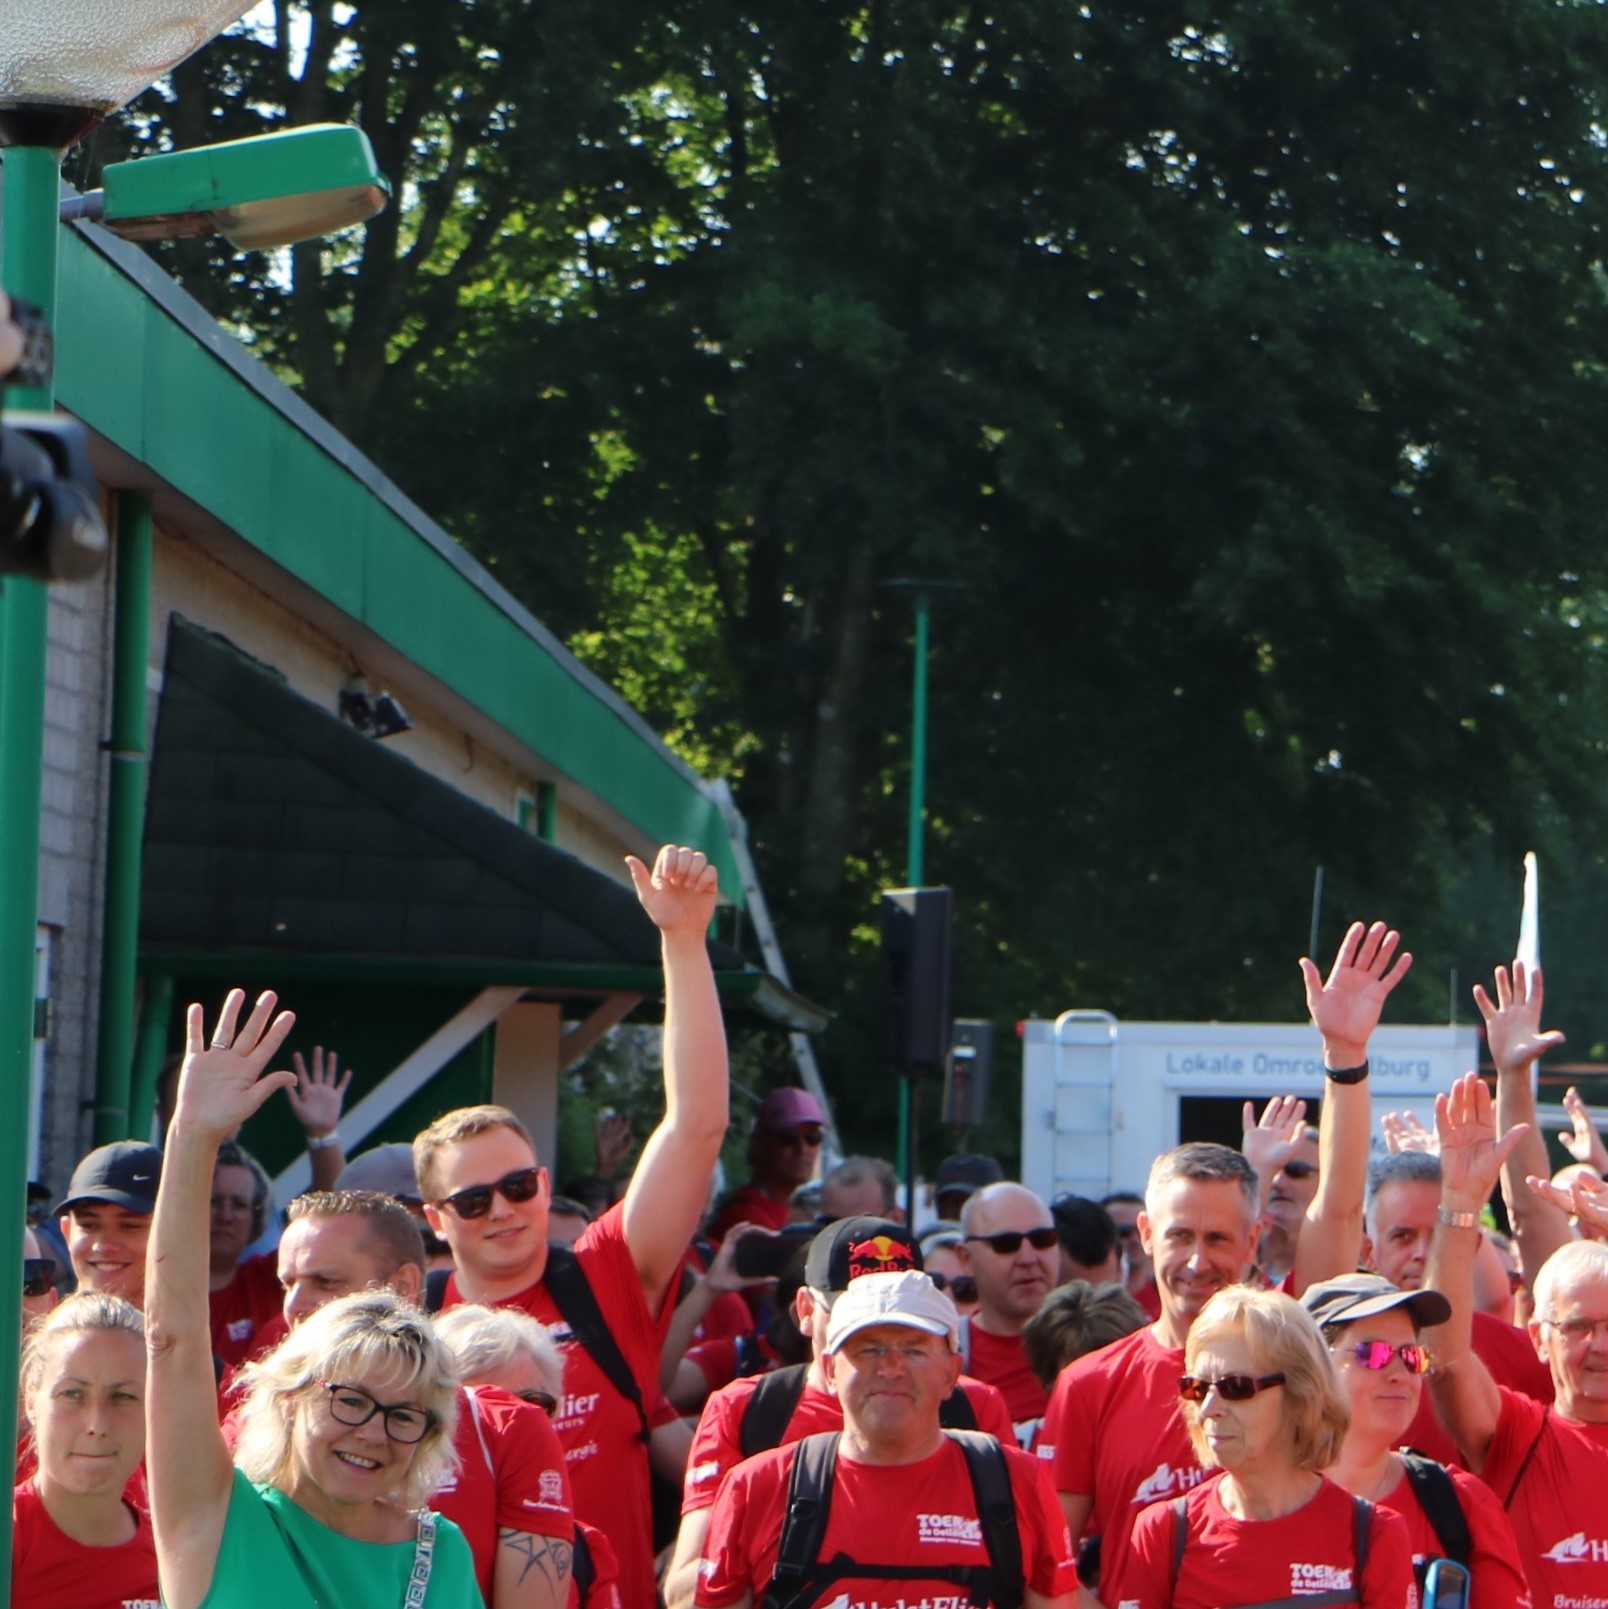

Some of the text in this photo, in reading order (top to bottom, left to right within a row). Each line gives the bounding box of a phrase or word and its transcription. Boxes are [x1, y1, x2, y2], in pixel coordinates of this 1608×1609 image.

[1166, 1053, 1243, 1075] Lokale
[1369, 1054, 1431, 1082] lburg
[916, 1513, 965, 1529] TOER
[1289, 1563, 1337, 1580] TOER
